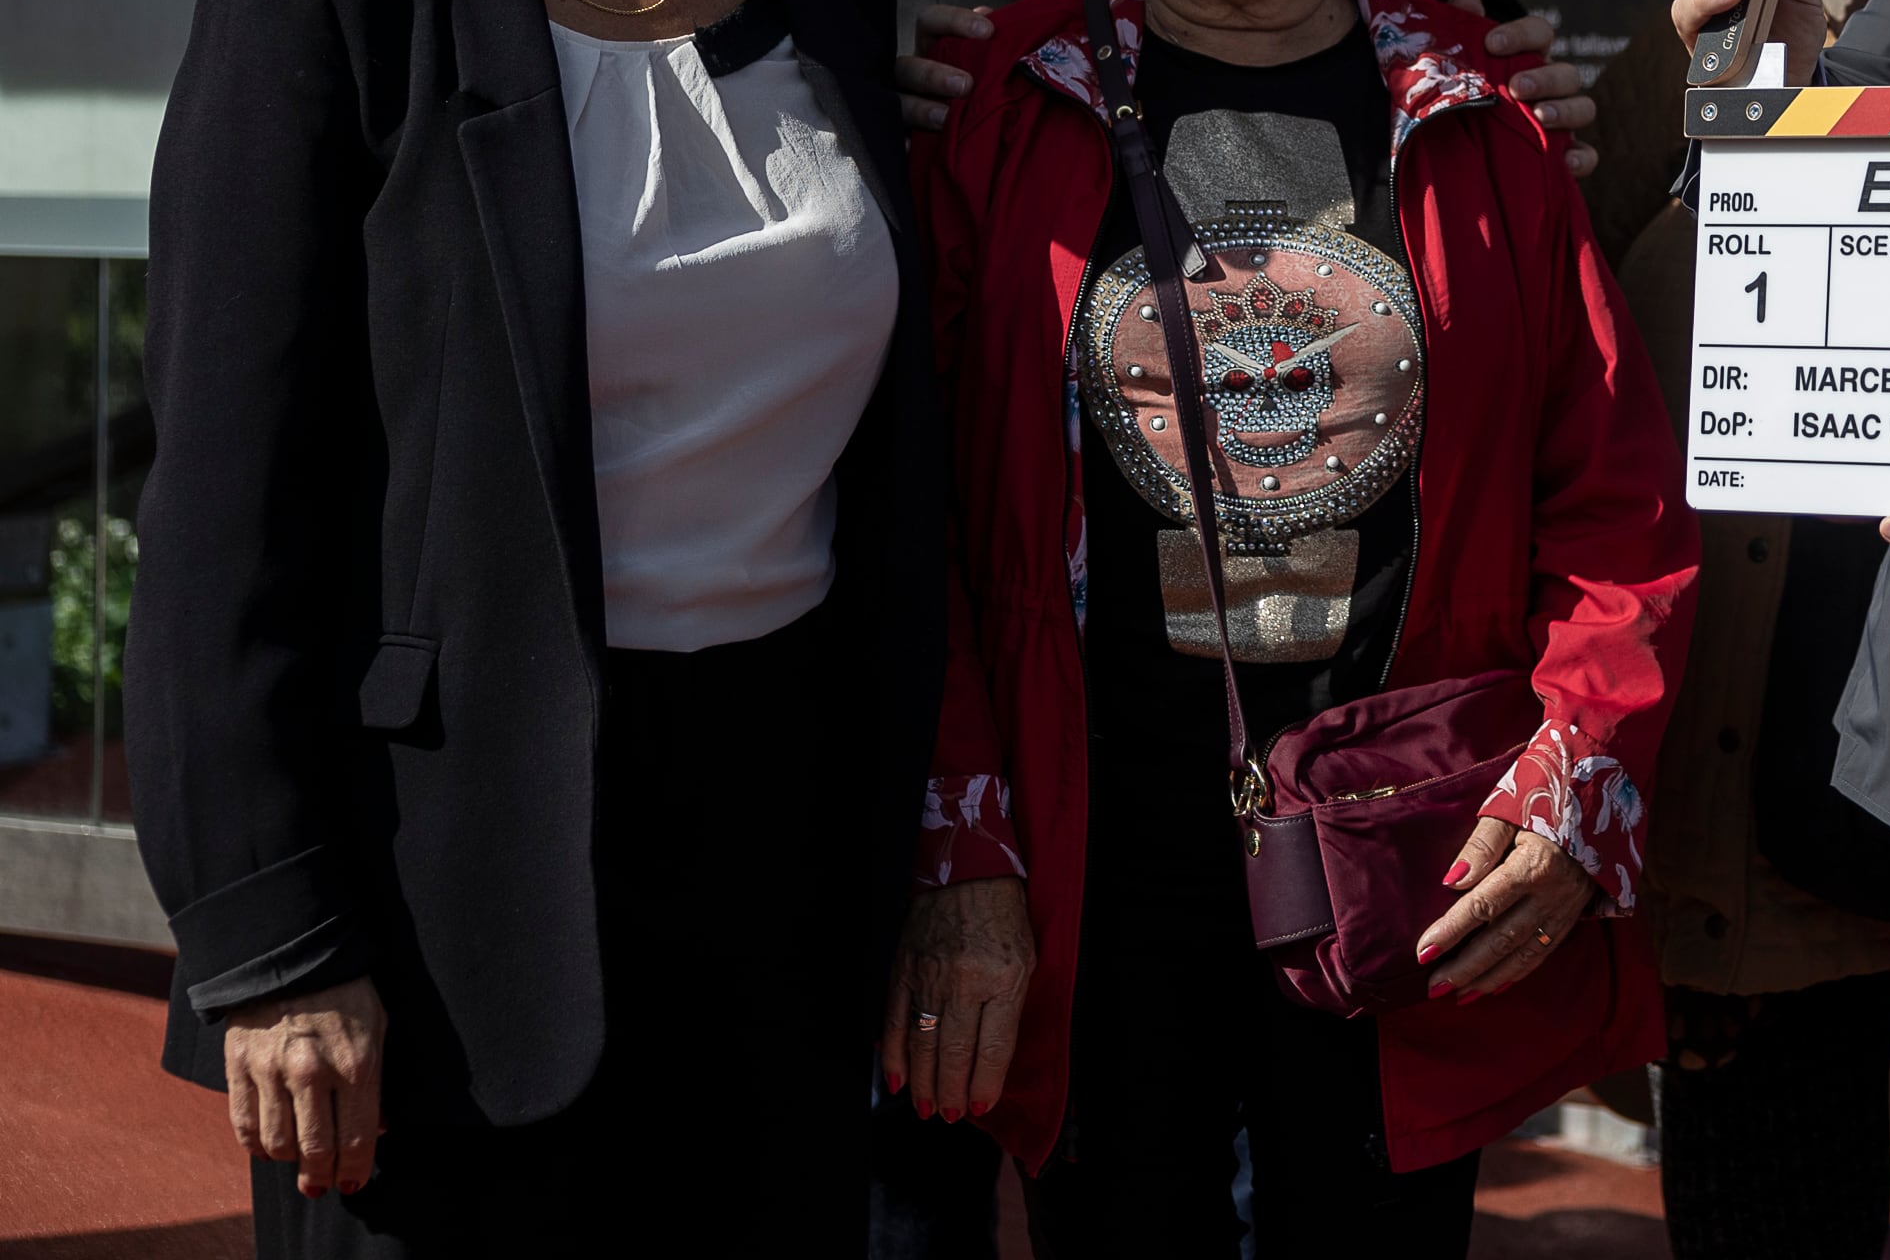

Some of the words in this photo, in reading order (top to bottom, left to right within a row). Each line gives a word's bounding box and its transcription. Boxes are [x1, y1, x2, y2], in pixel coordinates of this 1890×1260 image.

[1709, 192, 1758, 213] PROD.
[1708, 234, 1772, 256] ROLL
[1744, 271, 1768, 324] 1
[1702, 365, 1748, 391] DIR:
[1700, 410, 1753, 437] DoP:
[1793, 412, 1882, 440] ISAAC
[1697, 470, 1745, 488] DATE:
